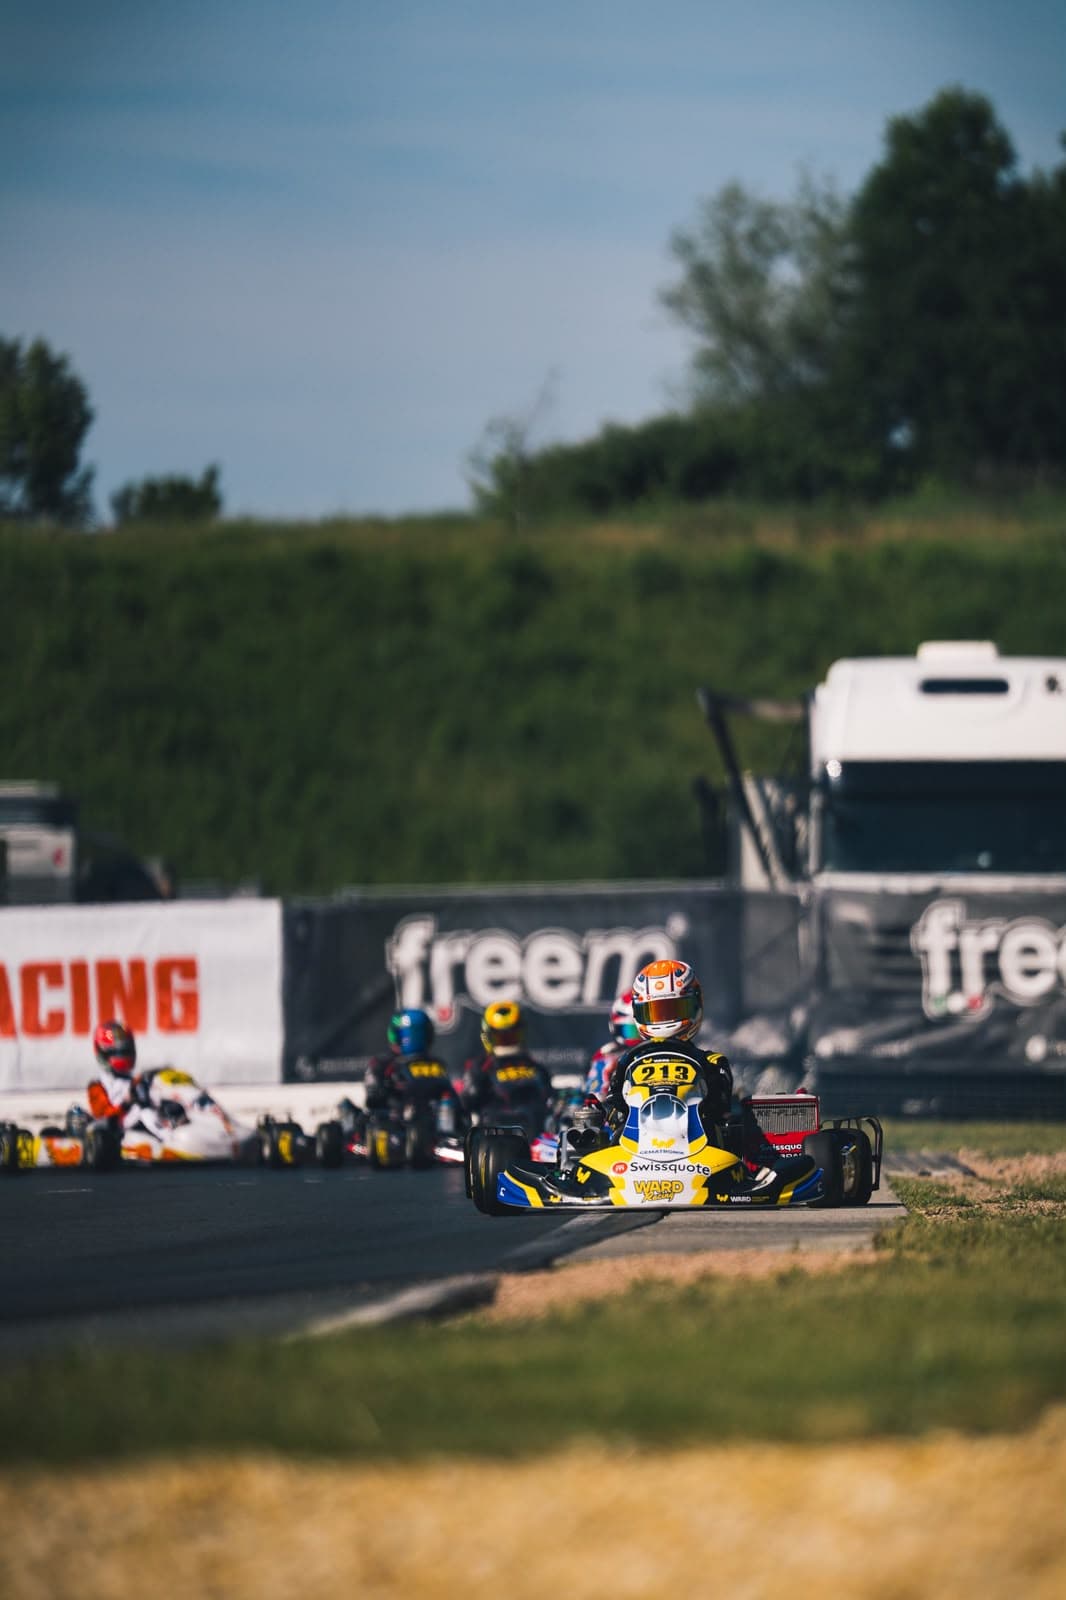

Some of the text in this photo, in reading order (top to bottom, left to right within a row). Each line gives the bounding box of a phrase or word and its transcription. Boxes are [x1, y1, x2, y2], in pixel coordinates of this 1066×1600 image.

[911, 900, 1066, 1020] fre
[641, 1065, 689, 1081] 213
[630, 1162, 710, 1175] Swissquote
[633, 1180, 684, 1194] WARD
[641, 1191, 675, 1203] Racing
